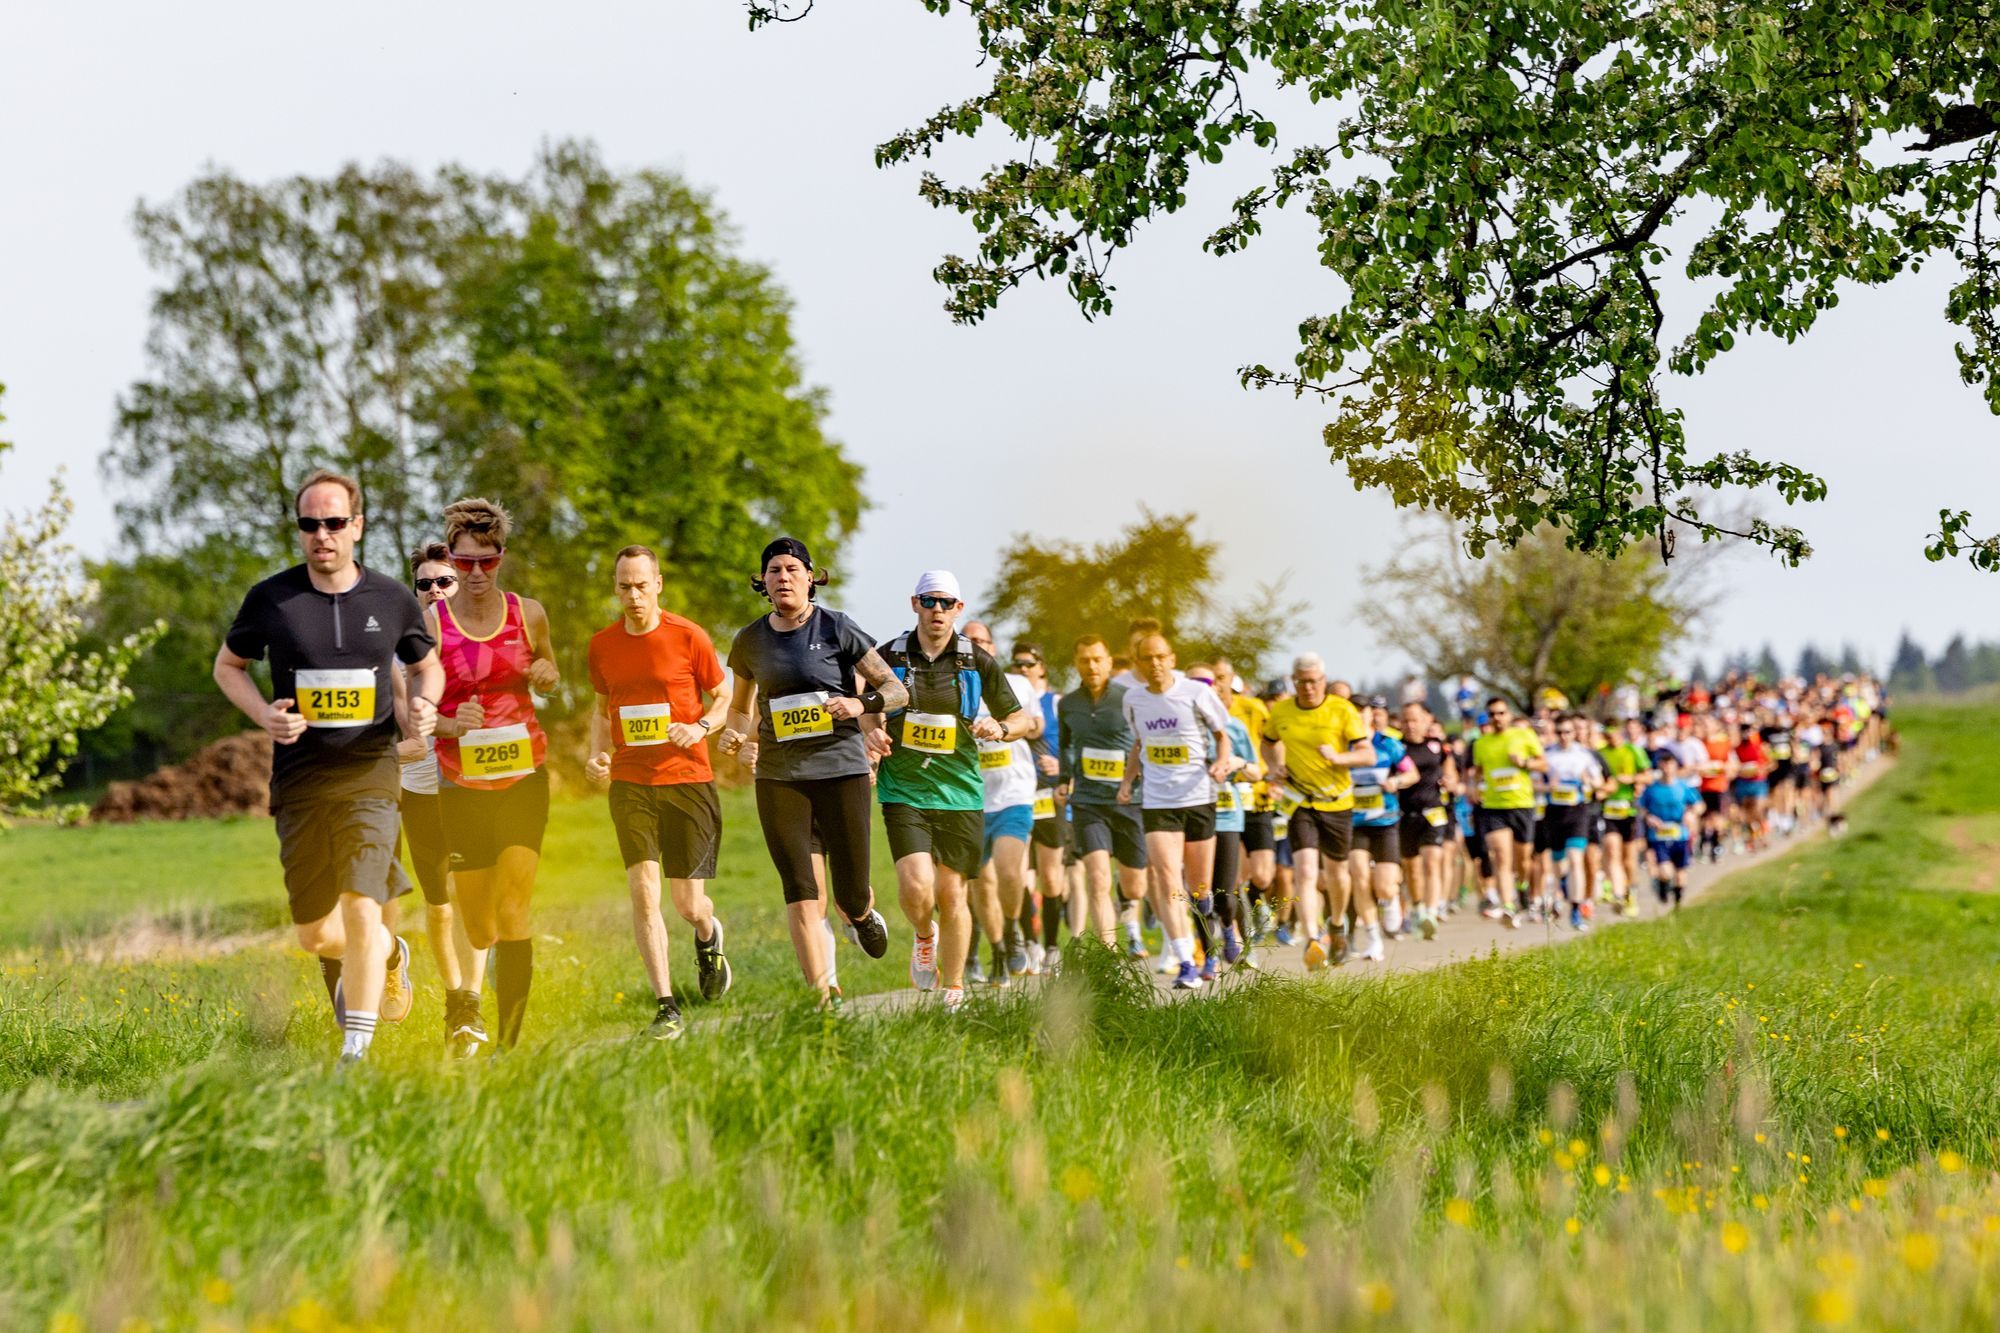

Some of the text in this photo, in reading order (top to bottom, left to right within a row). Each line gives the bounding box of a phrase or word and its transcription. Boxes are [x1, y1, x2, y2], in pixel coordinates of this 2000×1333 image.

[311, 690, 360, 708] 2153
[317, 711, 354, 720] Matthias
[782, 708, 820, 726] 2026
[629, 718, 659, 733] 2071
[1145, 717, 1178, 730] wtw
[912, 725, 946, 741] 2114
[474, 743, 520, 764] 2269
[1153, 747, 1182, 758] 2138
[1089, 760, 1116, 771] 2172
